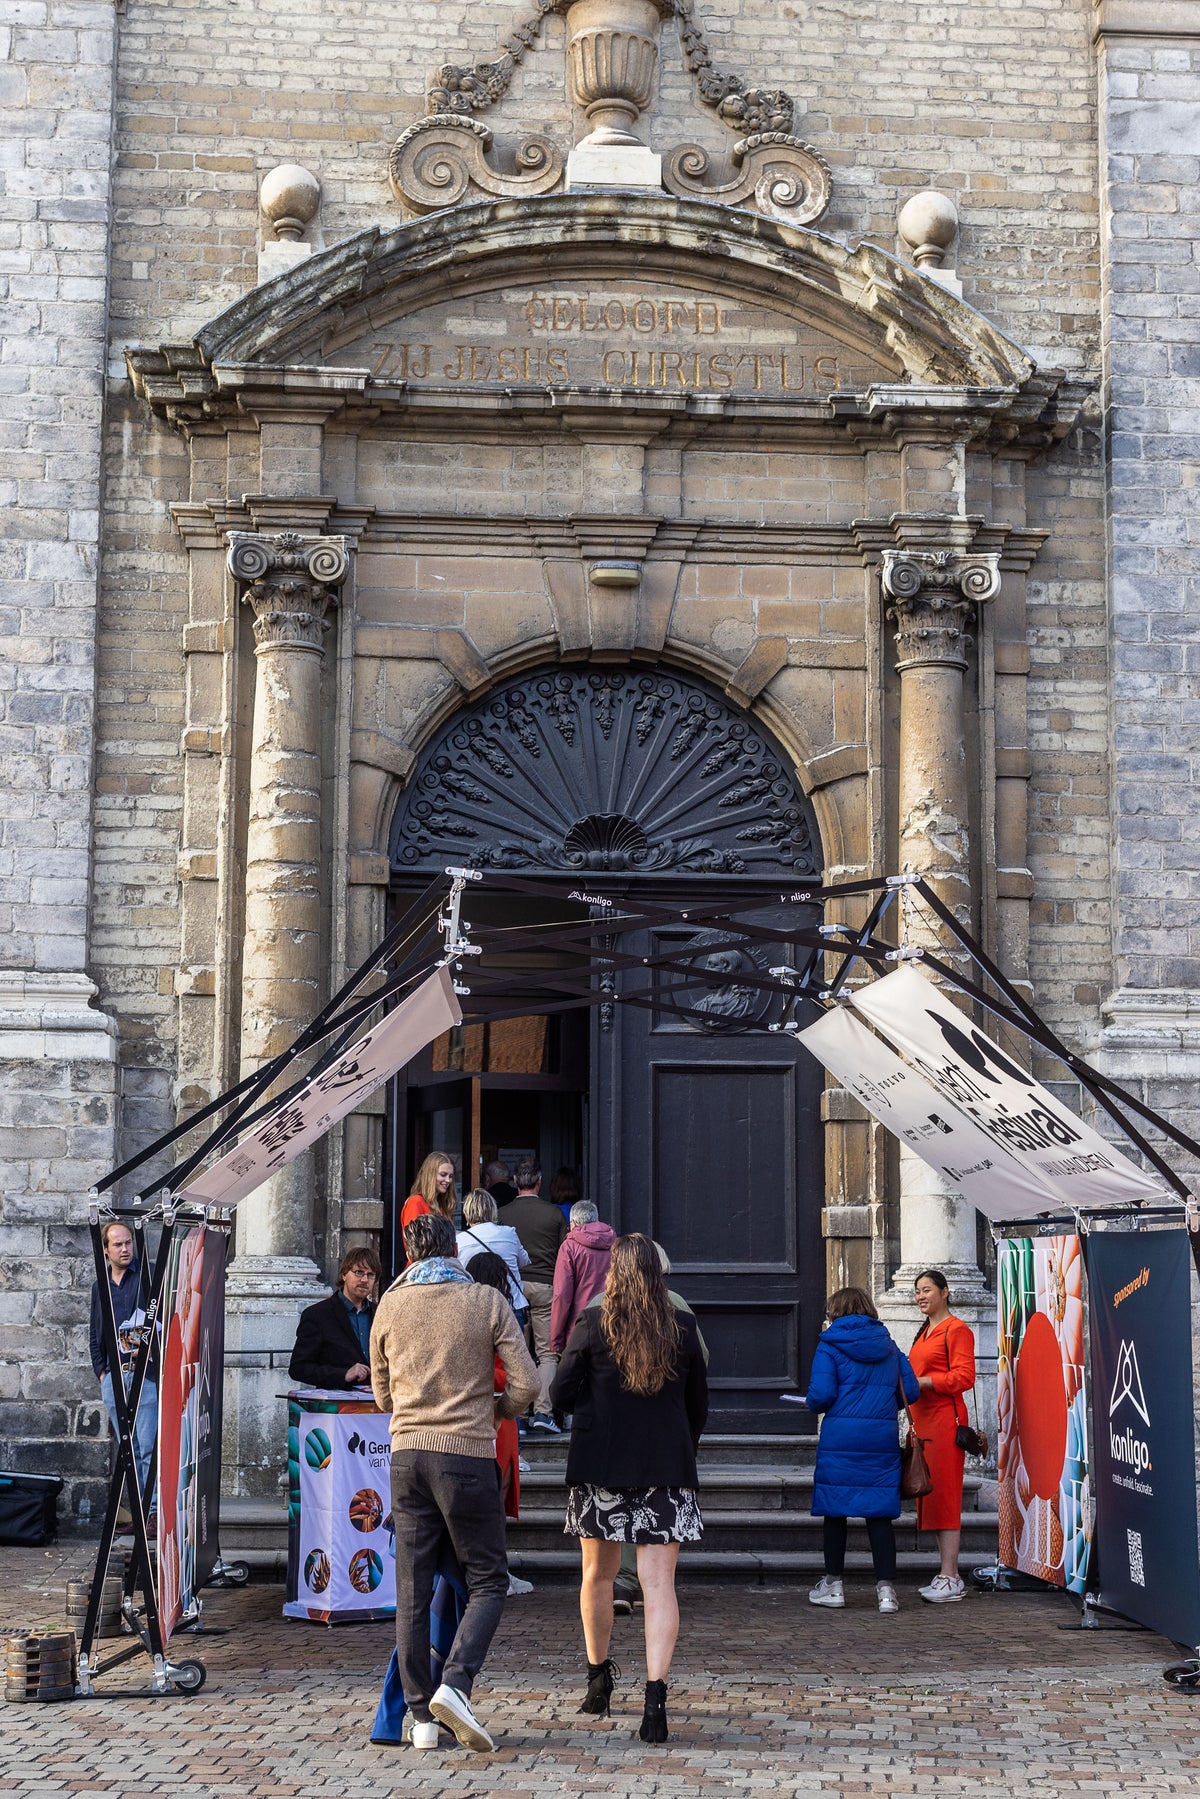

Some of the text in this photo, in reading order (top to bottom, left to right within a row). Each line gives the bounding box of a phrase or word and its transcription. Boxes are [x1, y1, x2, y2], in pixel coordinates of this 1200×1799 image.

[526, 297, 722, 335] GELOOFD
[371, 343, 842, 392] ZIJ JESUS CHRISTUS
[582, 892, 613, 907] konligo
[780, 892, 811, 903] knligo
[877, 1071, 906, 1090] VOLVO
[915, 1054, 991, 1102] Gent
[966, 1092, 1083, 1152] Festival
[1113, 1266, 1151, 1309] sponsored by
[368, 1441, 391, 1455] Gen
[368, 1457, 386, 1468] van
